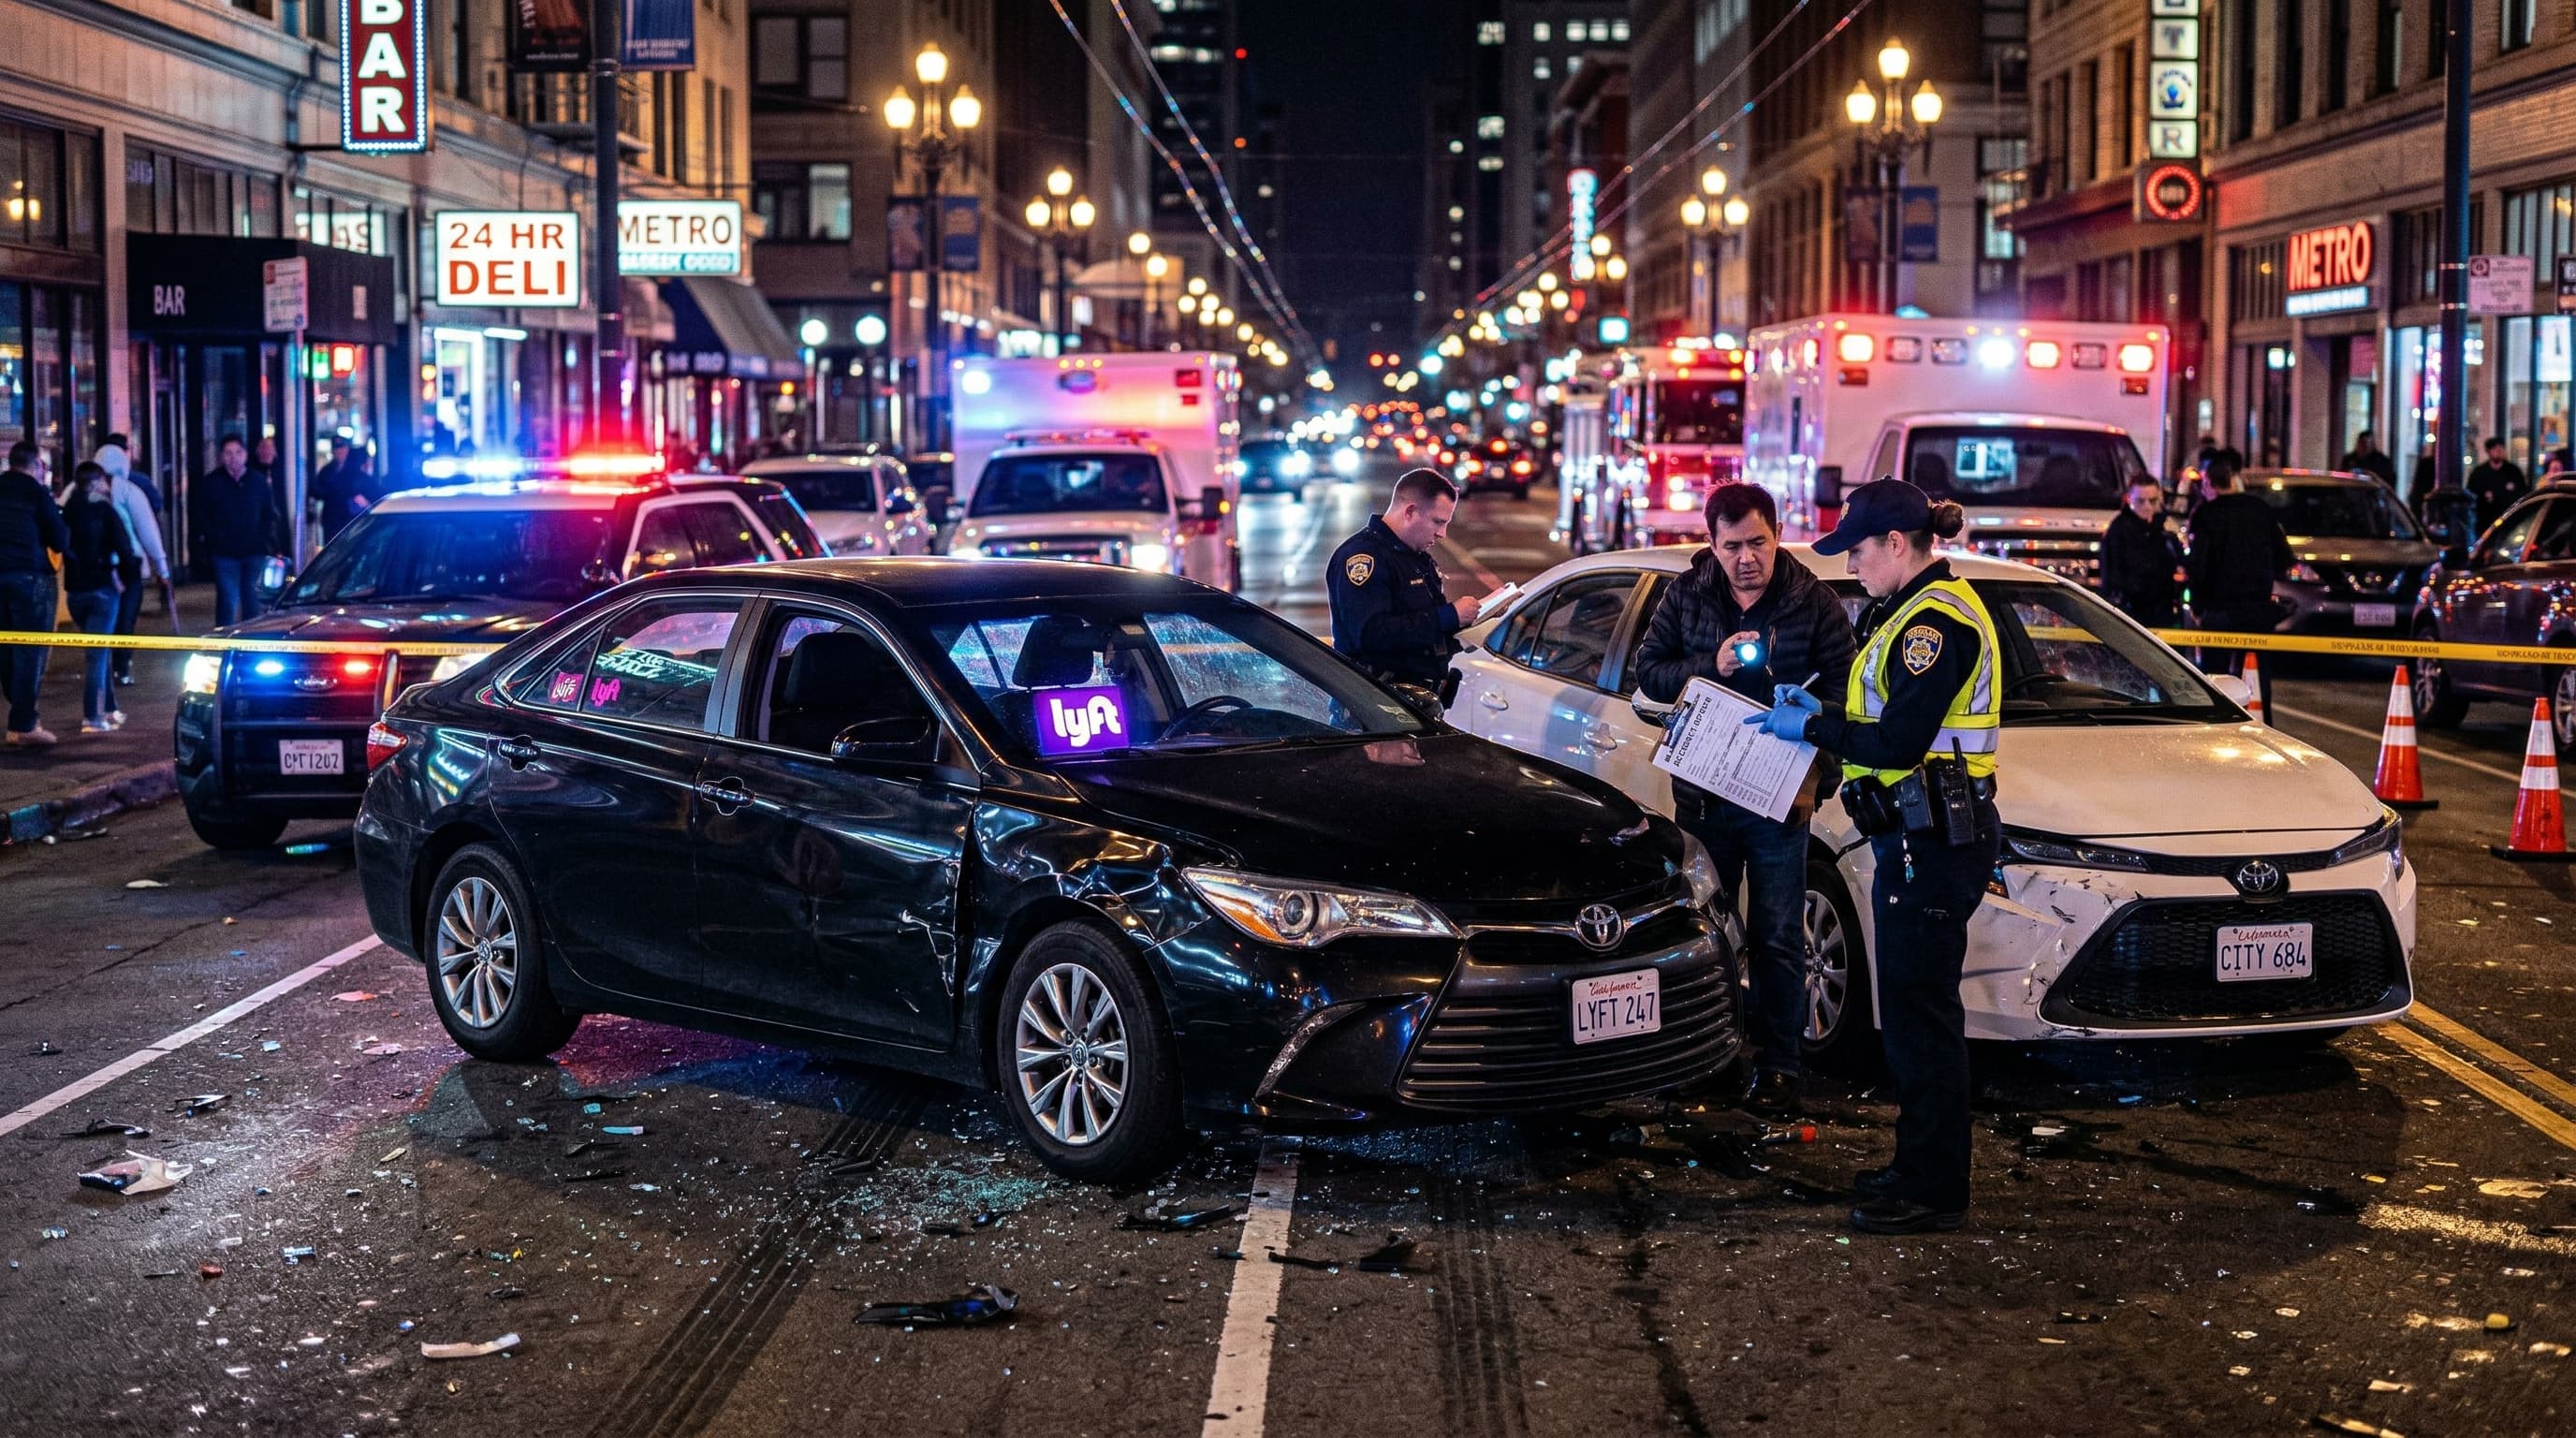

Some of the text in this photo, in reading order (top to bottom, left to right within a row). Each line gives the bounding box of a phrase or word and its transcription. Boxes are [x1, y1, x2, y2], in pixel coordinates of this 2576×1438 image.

[358, 0, 407, 133] BAR
[449, 222, 564, 249] 24 HR
[618, 215, 732, 244] METRO
[2287, 220, 2372, 291] METRO
[448, 260, 565, 295] DELI
[154, 284, 186, 315] BAR
[1048, 695, 1122, 748] lyft
[2220, 941, 2306, 971] CITY 684
[1577, 991, 1655, 1032] LYFT 247
